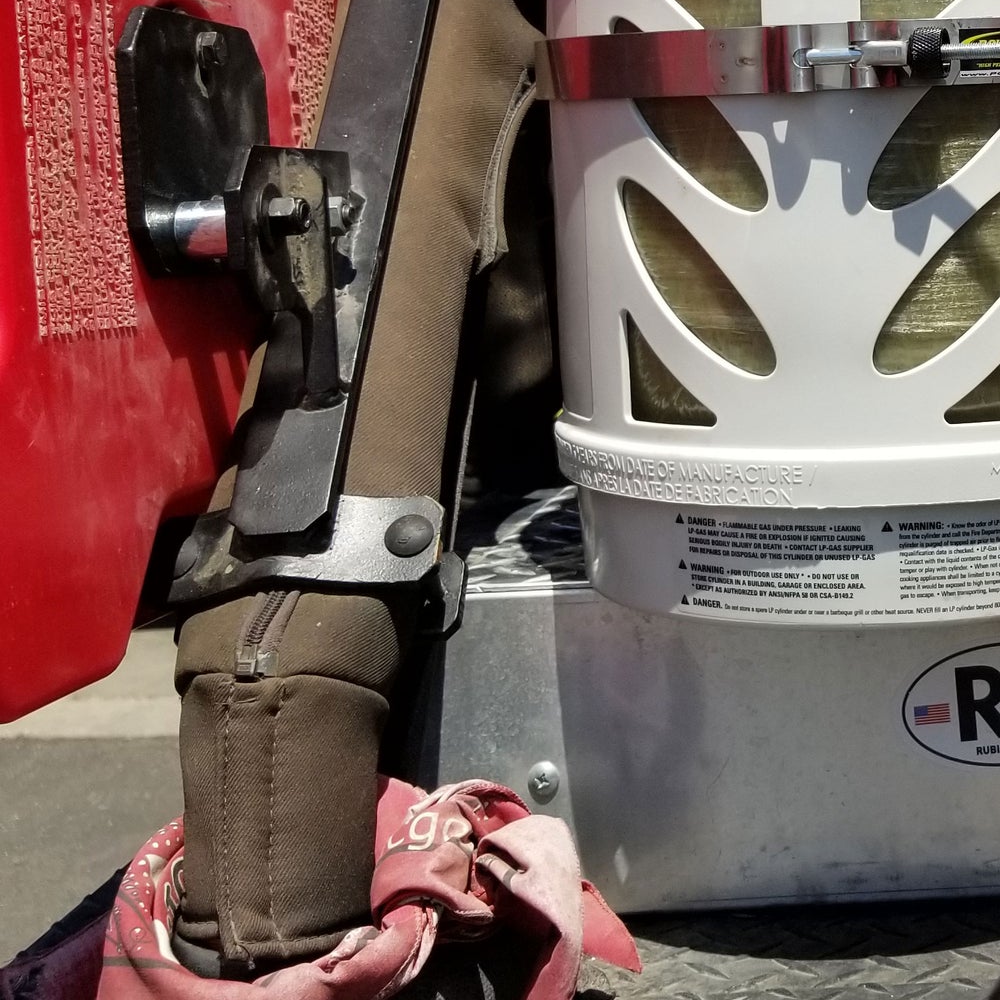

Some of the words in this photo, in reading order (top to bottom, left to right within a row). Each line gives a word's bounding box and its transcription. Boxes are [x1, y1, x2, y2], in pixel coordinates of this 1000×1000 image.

[626, 456, 654, 477] DATE
[658, 460, 675, 480] OF
[679, 462, 804, 486] MANUFACTURE
[619, 476, 632, 495] LA
[634, 480, 662, 500] DATE
[664, 483, 682, 501] DE
[686, 486, 793, 506] FABRICATION
[687, 516, 716, 527] DANGER
[722, 522, 757, 530] FLAMMABLE
[899, 522, 944, 531] WARNING:
[712, 539, 730, 547] BODILY
[700, 547, 721, 555] REPAIRS
[731, 550, 758, 558] DISPOSAL
[690, 563, 724, 574] WARNING
[708, 576, 733, 585] CYLINDER
[748, 580, 776, 588] BUILDING,
[696, 583, 714, 592] EXCEPT
[724, 588, 758, 596] AUTHORIZED
[692, 597, 722, 609] DANGER.
